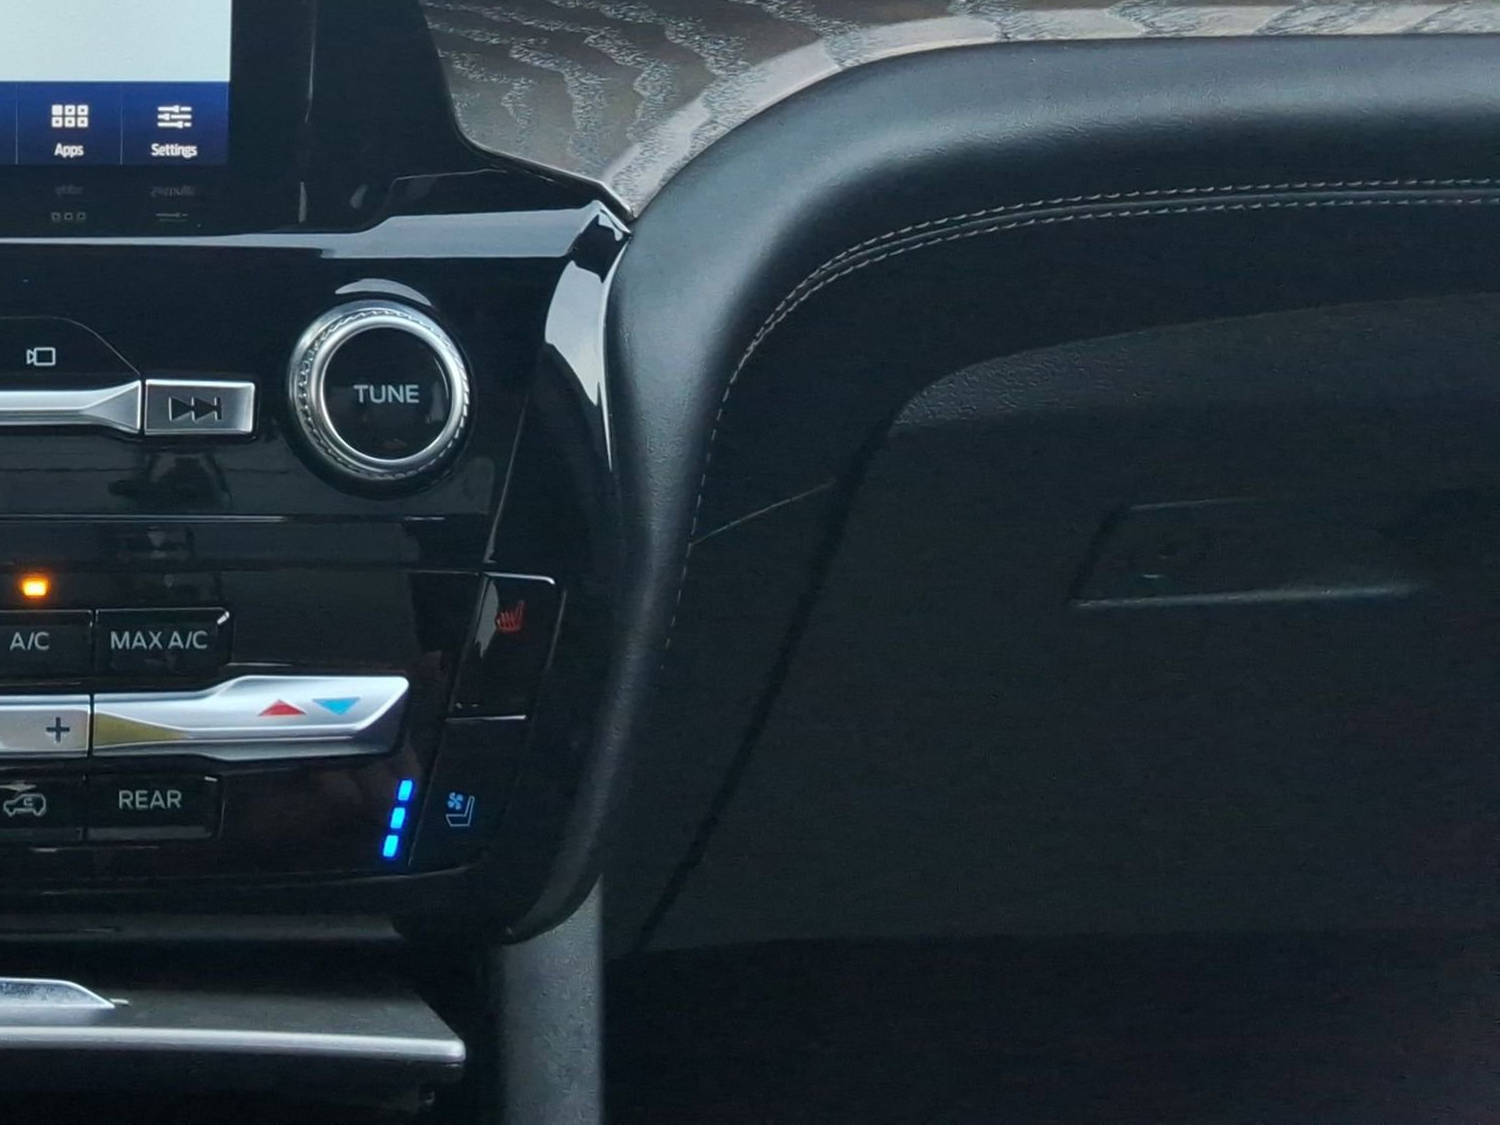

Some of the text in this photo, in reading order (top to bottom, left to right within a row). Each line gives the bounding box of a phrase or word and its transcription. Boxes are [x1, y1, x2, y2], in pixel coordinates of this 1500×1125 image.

[53, 143, 85, 159] Apps
[150, 143, 199, 159] Settings
[353, 384, 420, 404] TUNE
[9, 631, 50, 652] A/C
[109, 630, 209, 651] MAX A/C
[118, 790, 183, 809] REAR
